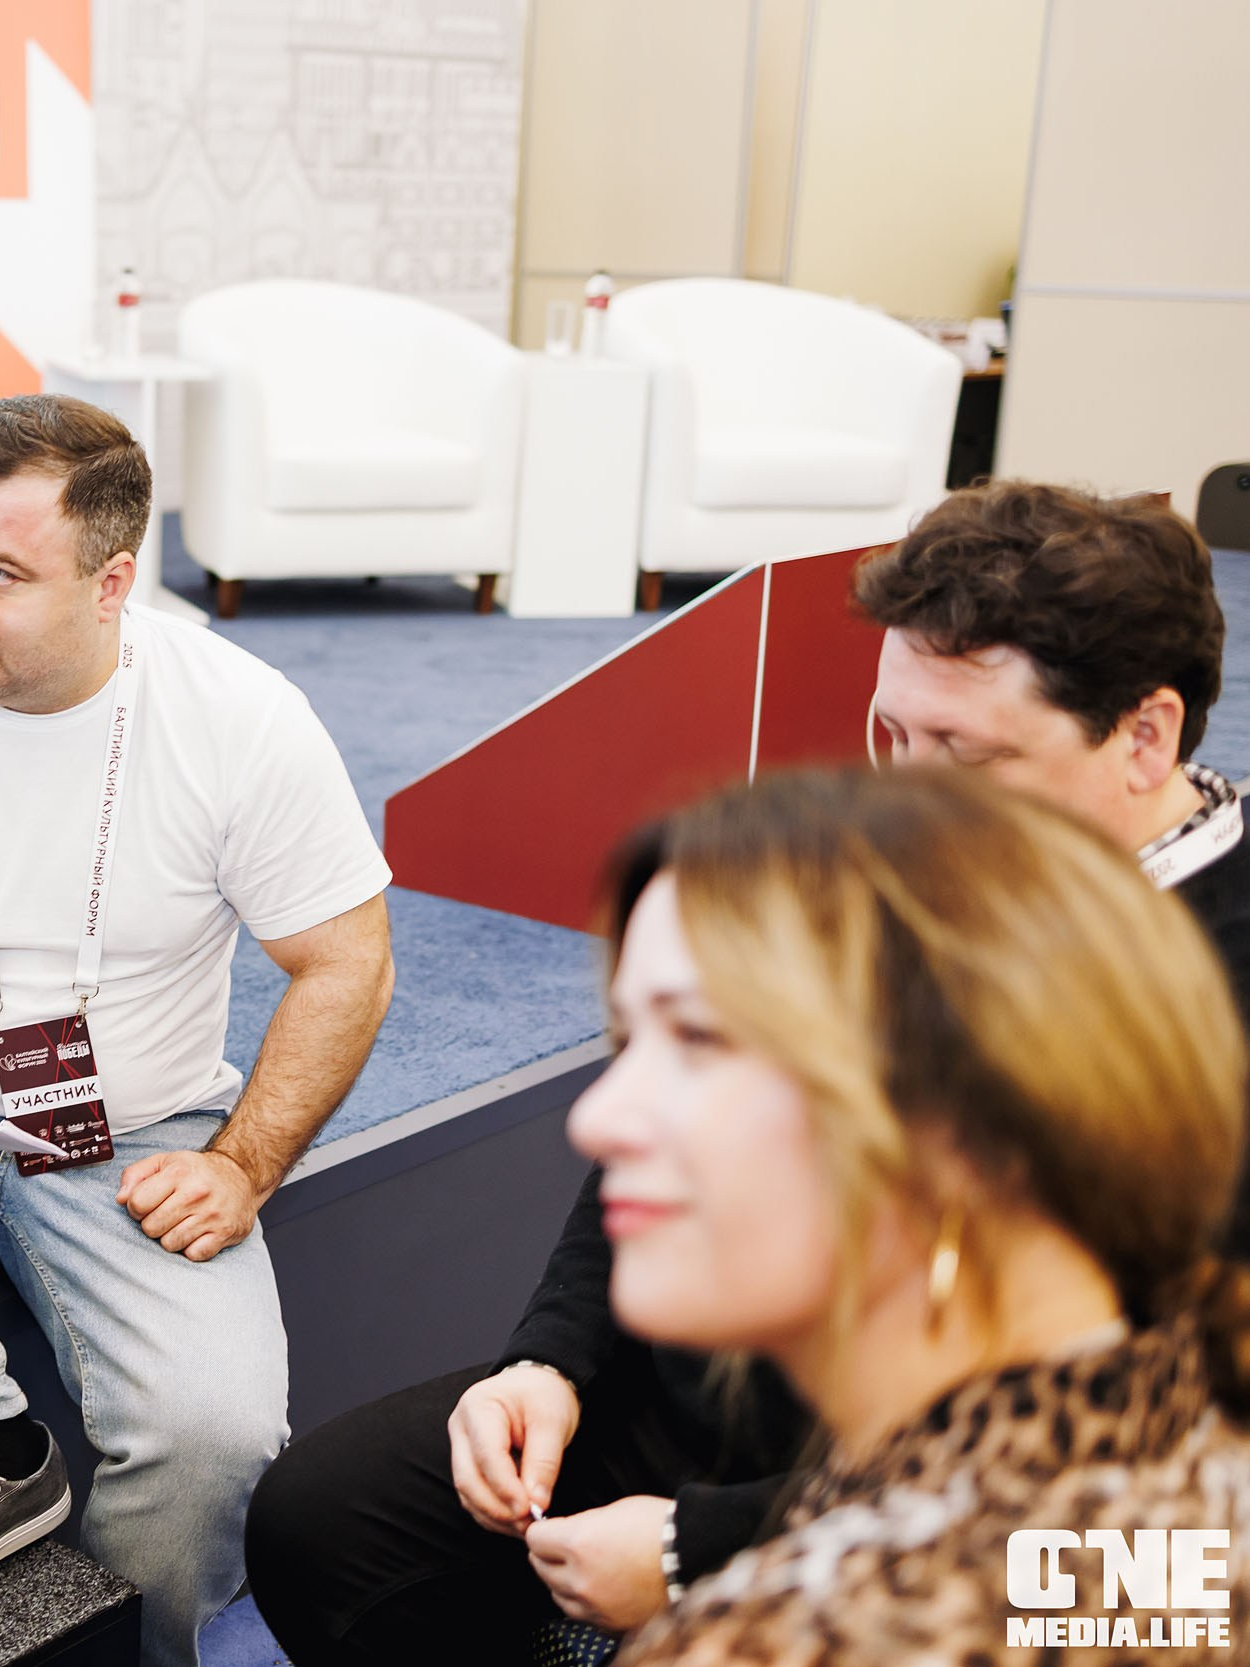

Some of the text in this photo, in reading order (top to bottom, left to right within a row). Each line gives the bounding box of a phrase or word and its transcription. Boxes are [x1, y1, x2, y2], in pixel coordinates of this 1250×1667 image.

[122, 642, 134, 669] 2025
[85, 706, 127, 937] БАЛТИЙСКИЙ КУЛЬТУРНЫЙ ФОРУМ
[56, 1043, 91, 1061] ПОБЕДЫ
[11, 1082, 98, 1110] УЧАСТНИК
